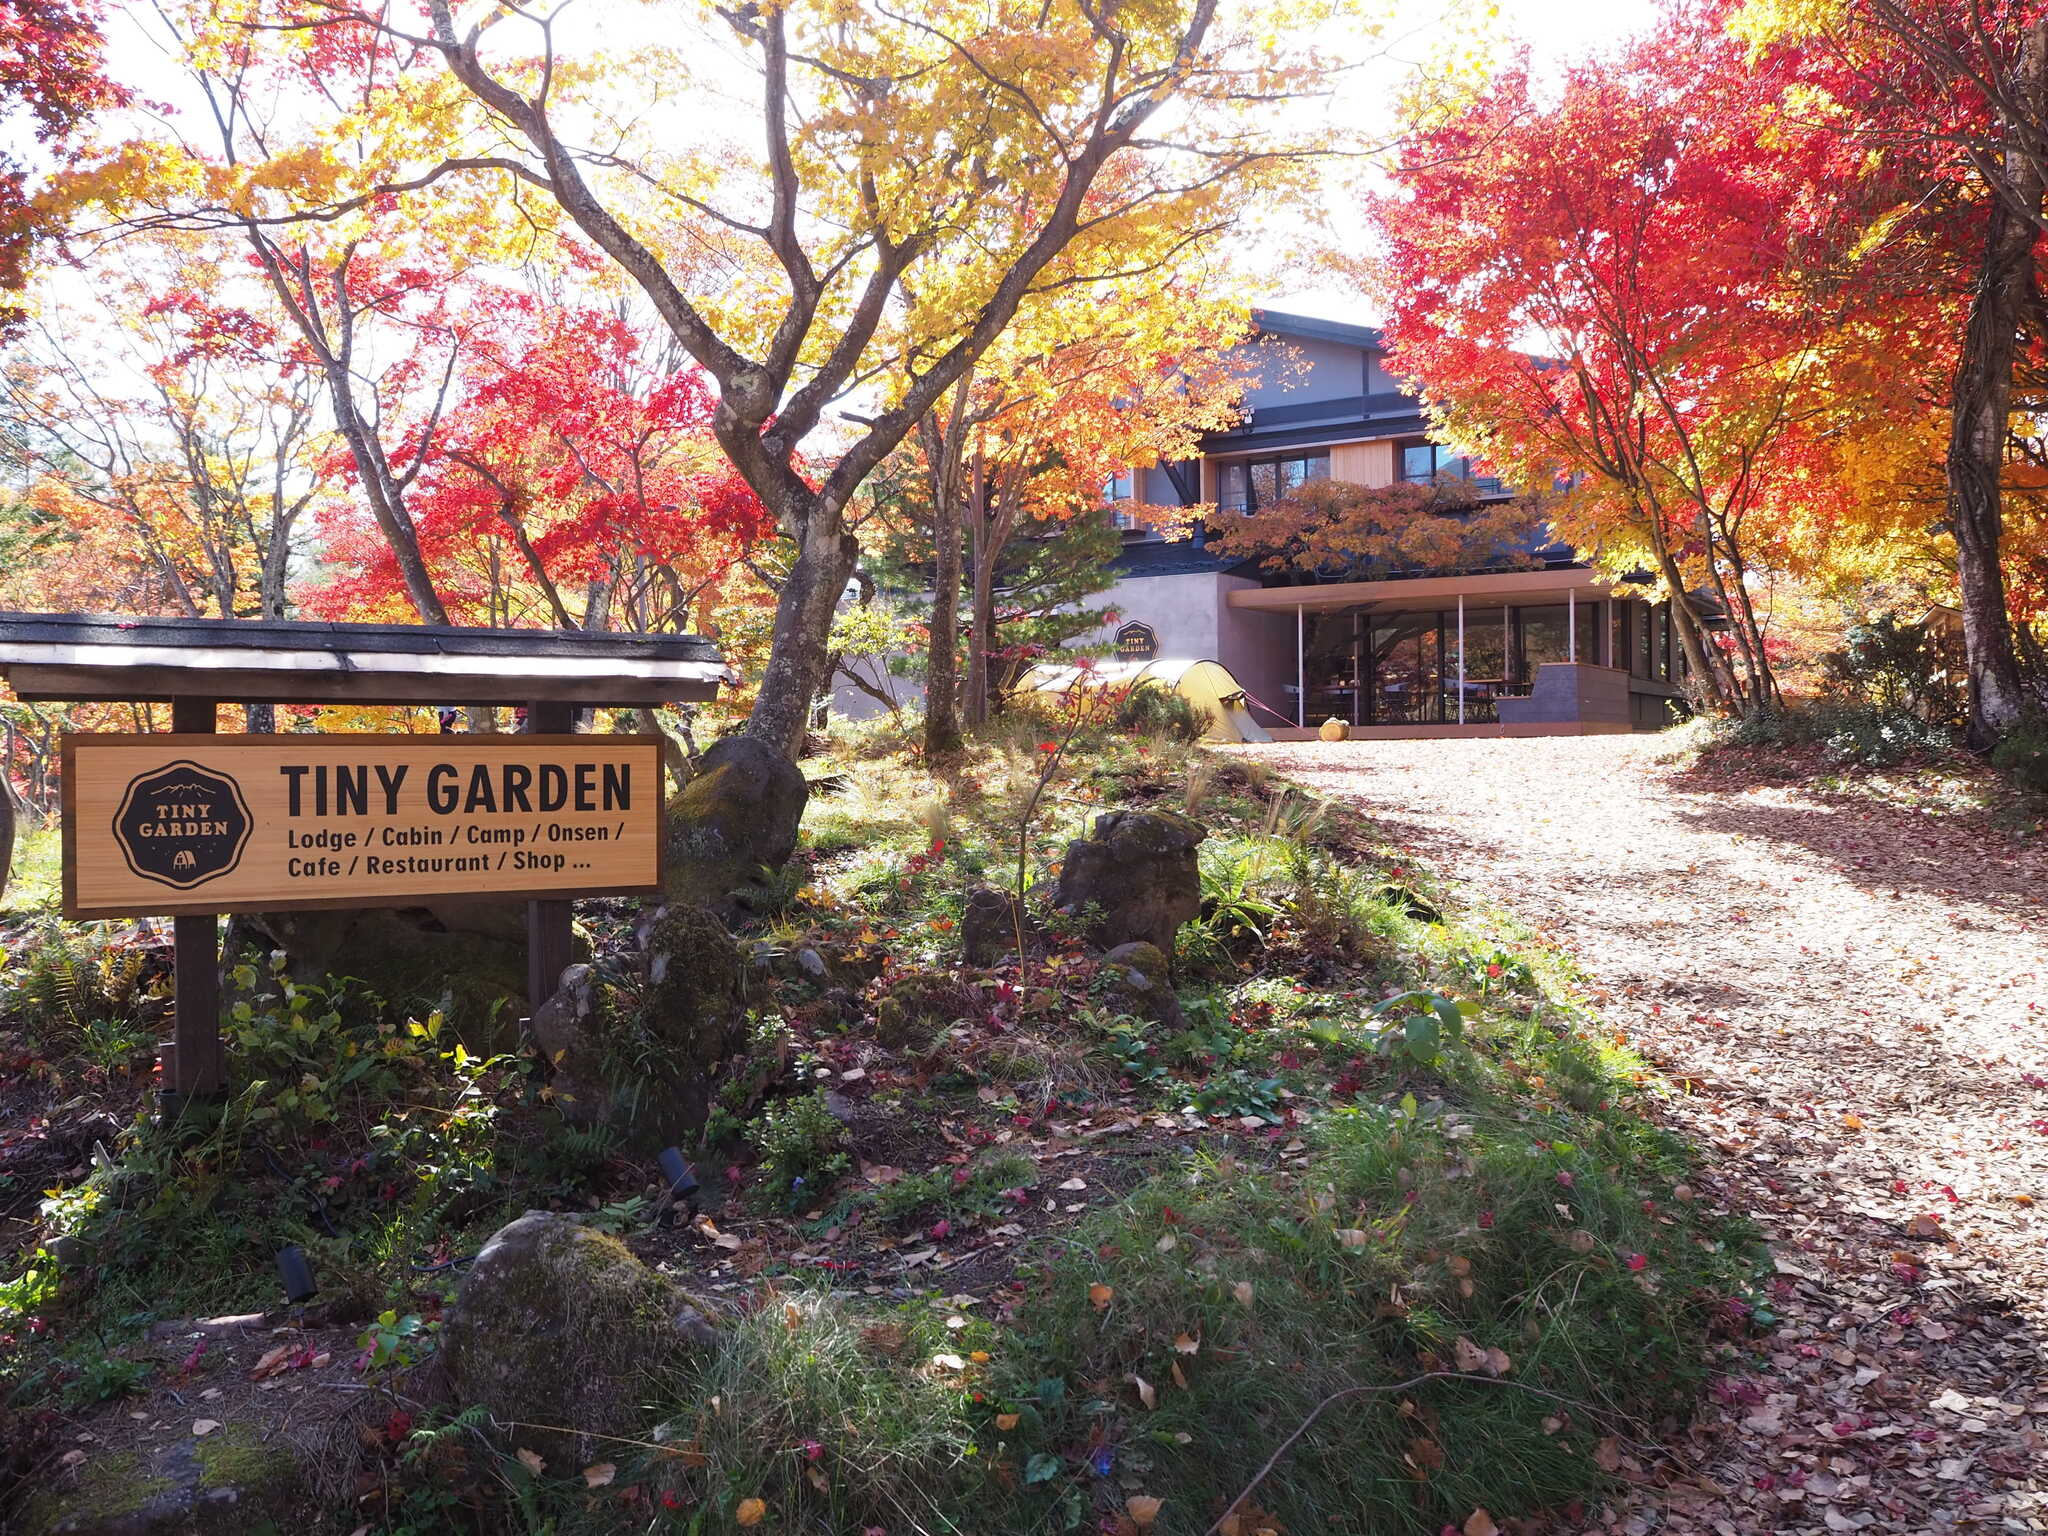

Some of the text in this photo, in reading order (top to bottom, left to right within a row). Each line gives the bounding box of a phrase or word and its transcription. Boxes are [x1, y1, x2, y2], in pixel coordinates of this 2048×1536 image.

[1126, 637, 1145, 645] TINY
[280, 763, 631, 816] TINY GARDEN
[156, 804, 211, 819] TINY
[139, 821, 228, 837] GARDEN
[288, 829, 357, 852] Lodge
[382, 826, 443, 846] Cabin
[467, 825, 525, 847] Camp
[548, 823, 608, 842] Onsen
[288, 857, 341, 877] Cafe
[367, 854, 489, 874] Restaurant
[513, 851, 565, 872] Shop
